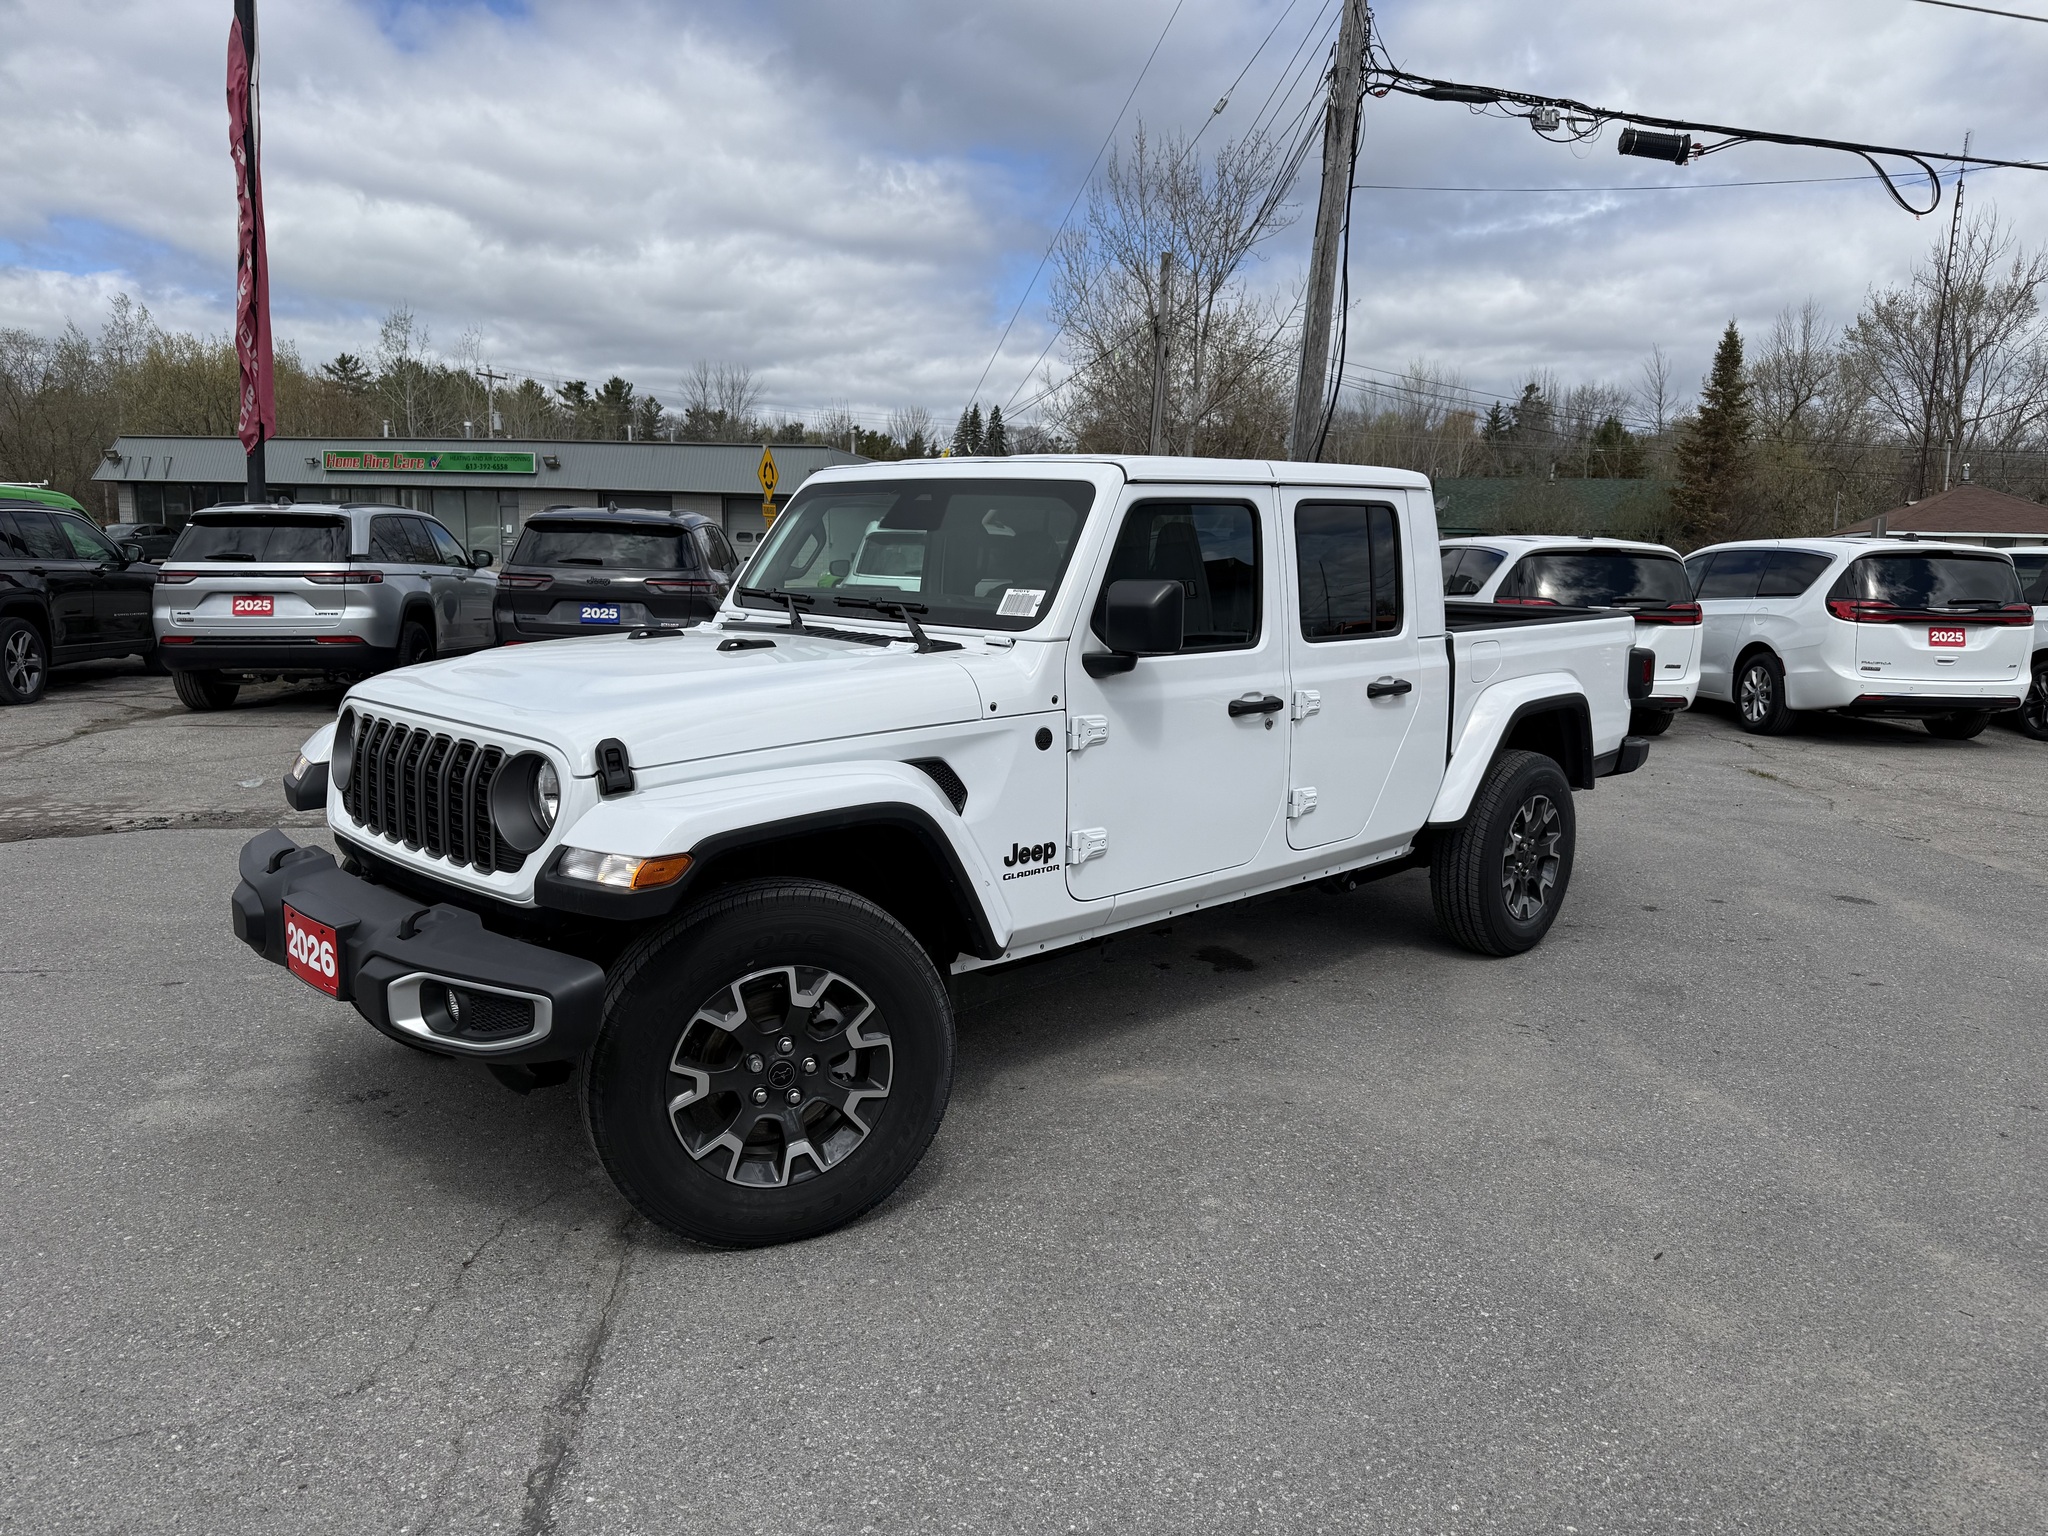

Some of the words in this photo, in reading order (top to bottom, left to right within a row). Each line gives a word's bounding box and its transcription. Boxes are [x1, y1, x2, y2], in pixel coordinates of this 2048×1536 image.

[325, 453, 361, 469] Home
[393, 453, 425, 470] Care
[235, 600, 271, 611] 2025
[581, 607, 618, 619] 2025
[1931, 631, 1964, 643] 2025
[1003, 841, 1057, 868] Jeep
[1002, 864, 1060, 881] GLADIATOR
[287, 921, 336, 978] 2026
